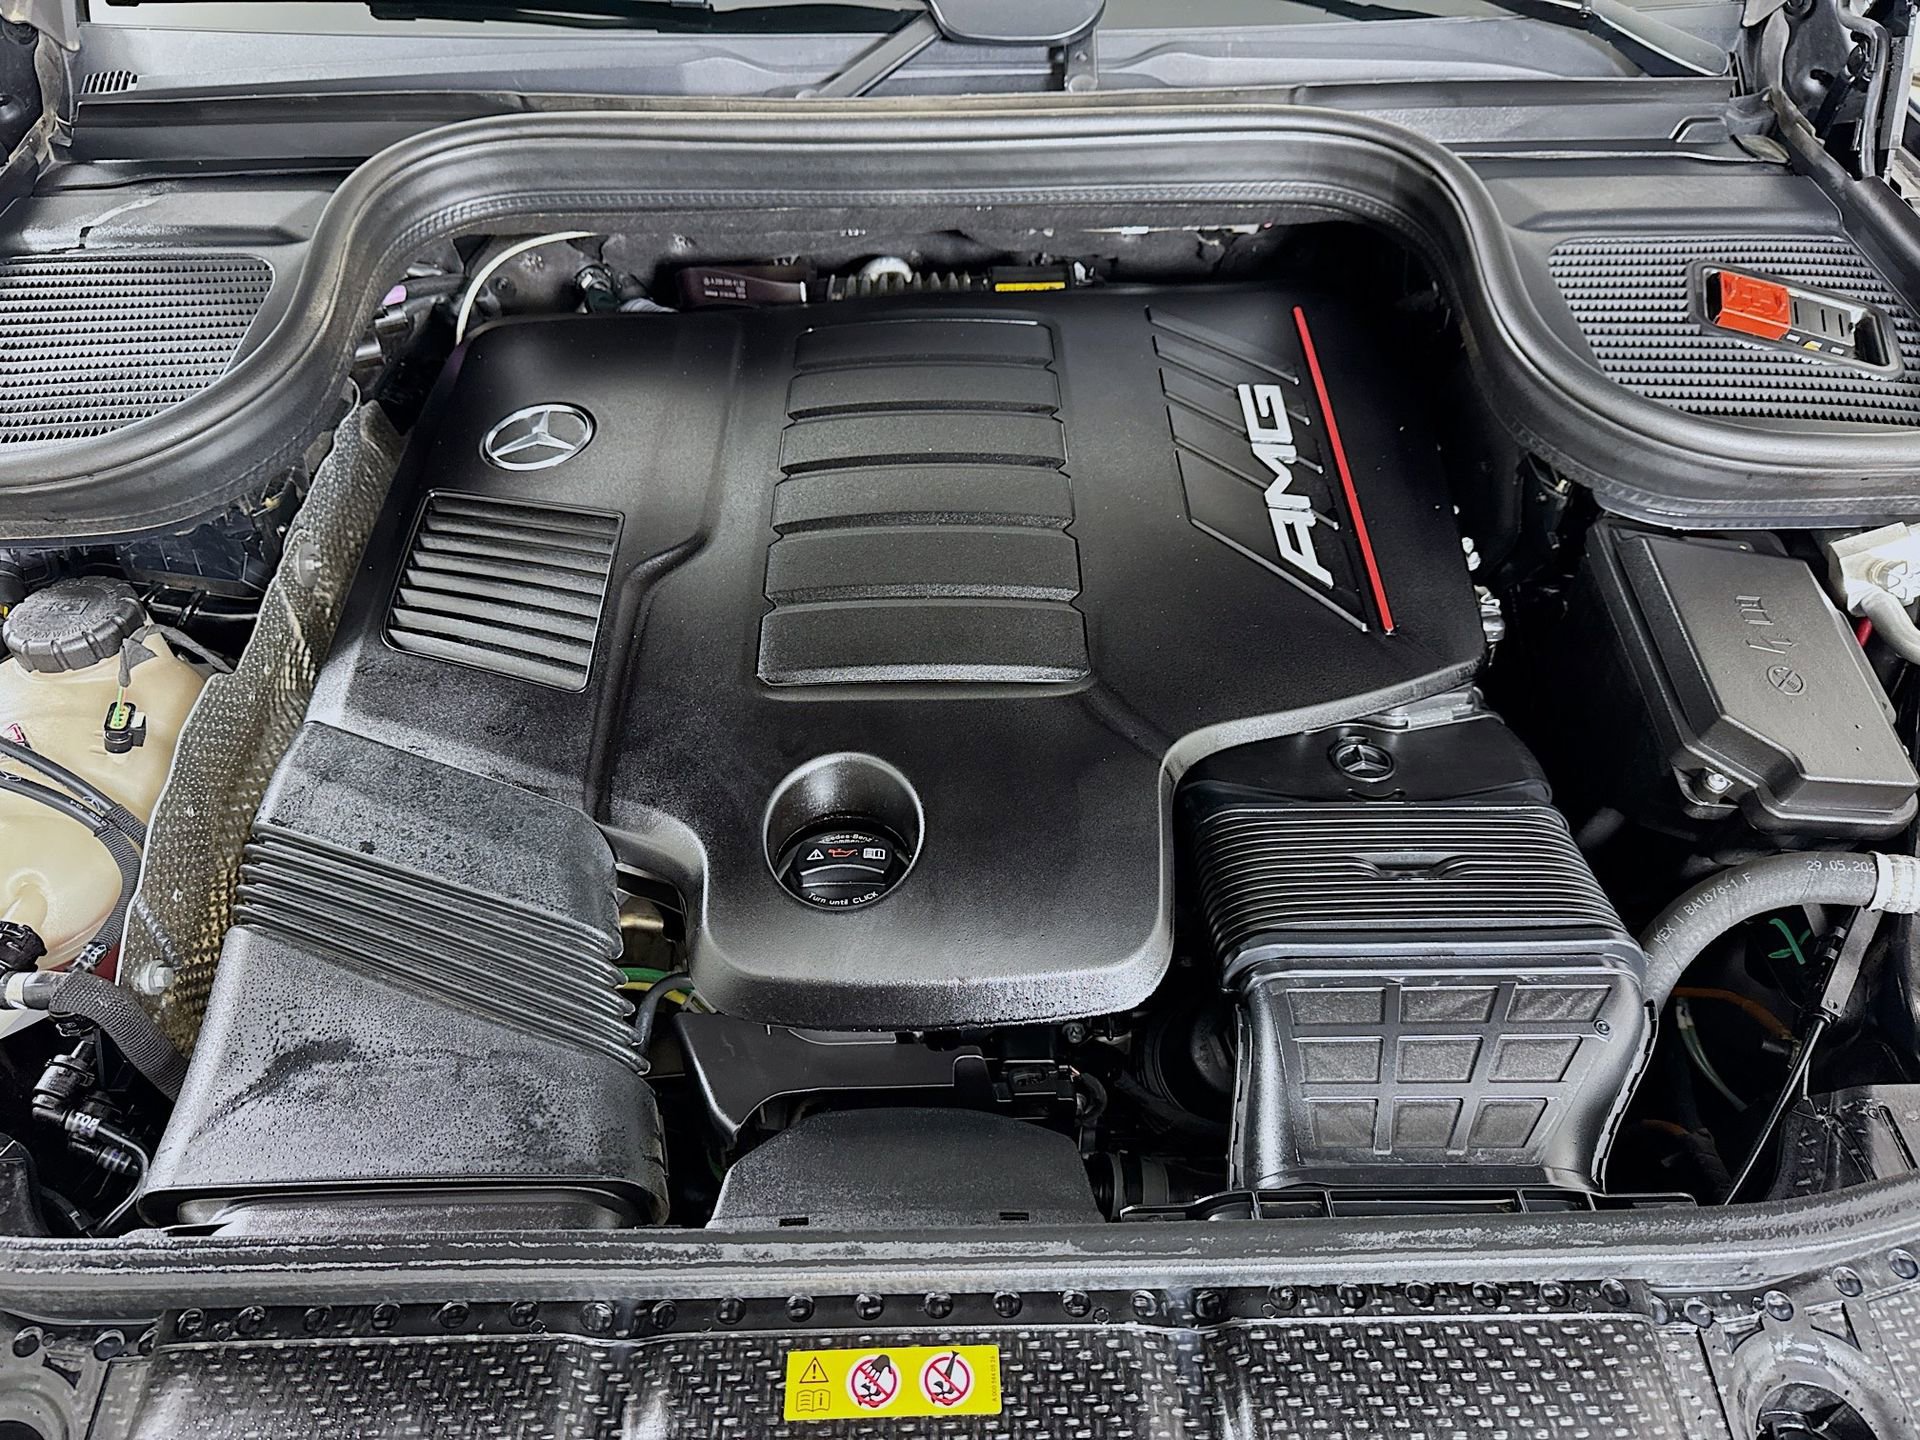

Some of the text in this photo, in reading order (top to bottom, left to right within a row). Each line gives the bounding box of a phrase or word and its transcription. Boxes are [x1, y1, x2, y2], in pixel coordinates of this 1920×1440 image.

[1237, 383, 1334, 589] AMG
[1742, 872, 1752, 884] F
[808, 892, 826, 904] Turn
[852, 891, 879, 904] CLICK
[75, 1112, 100, 1129] TOP
